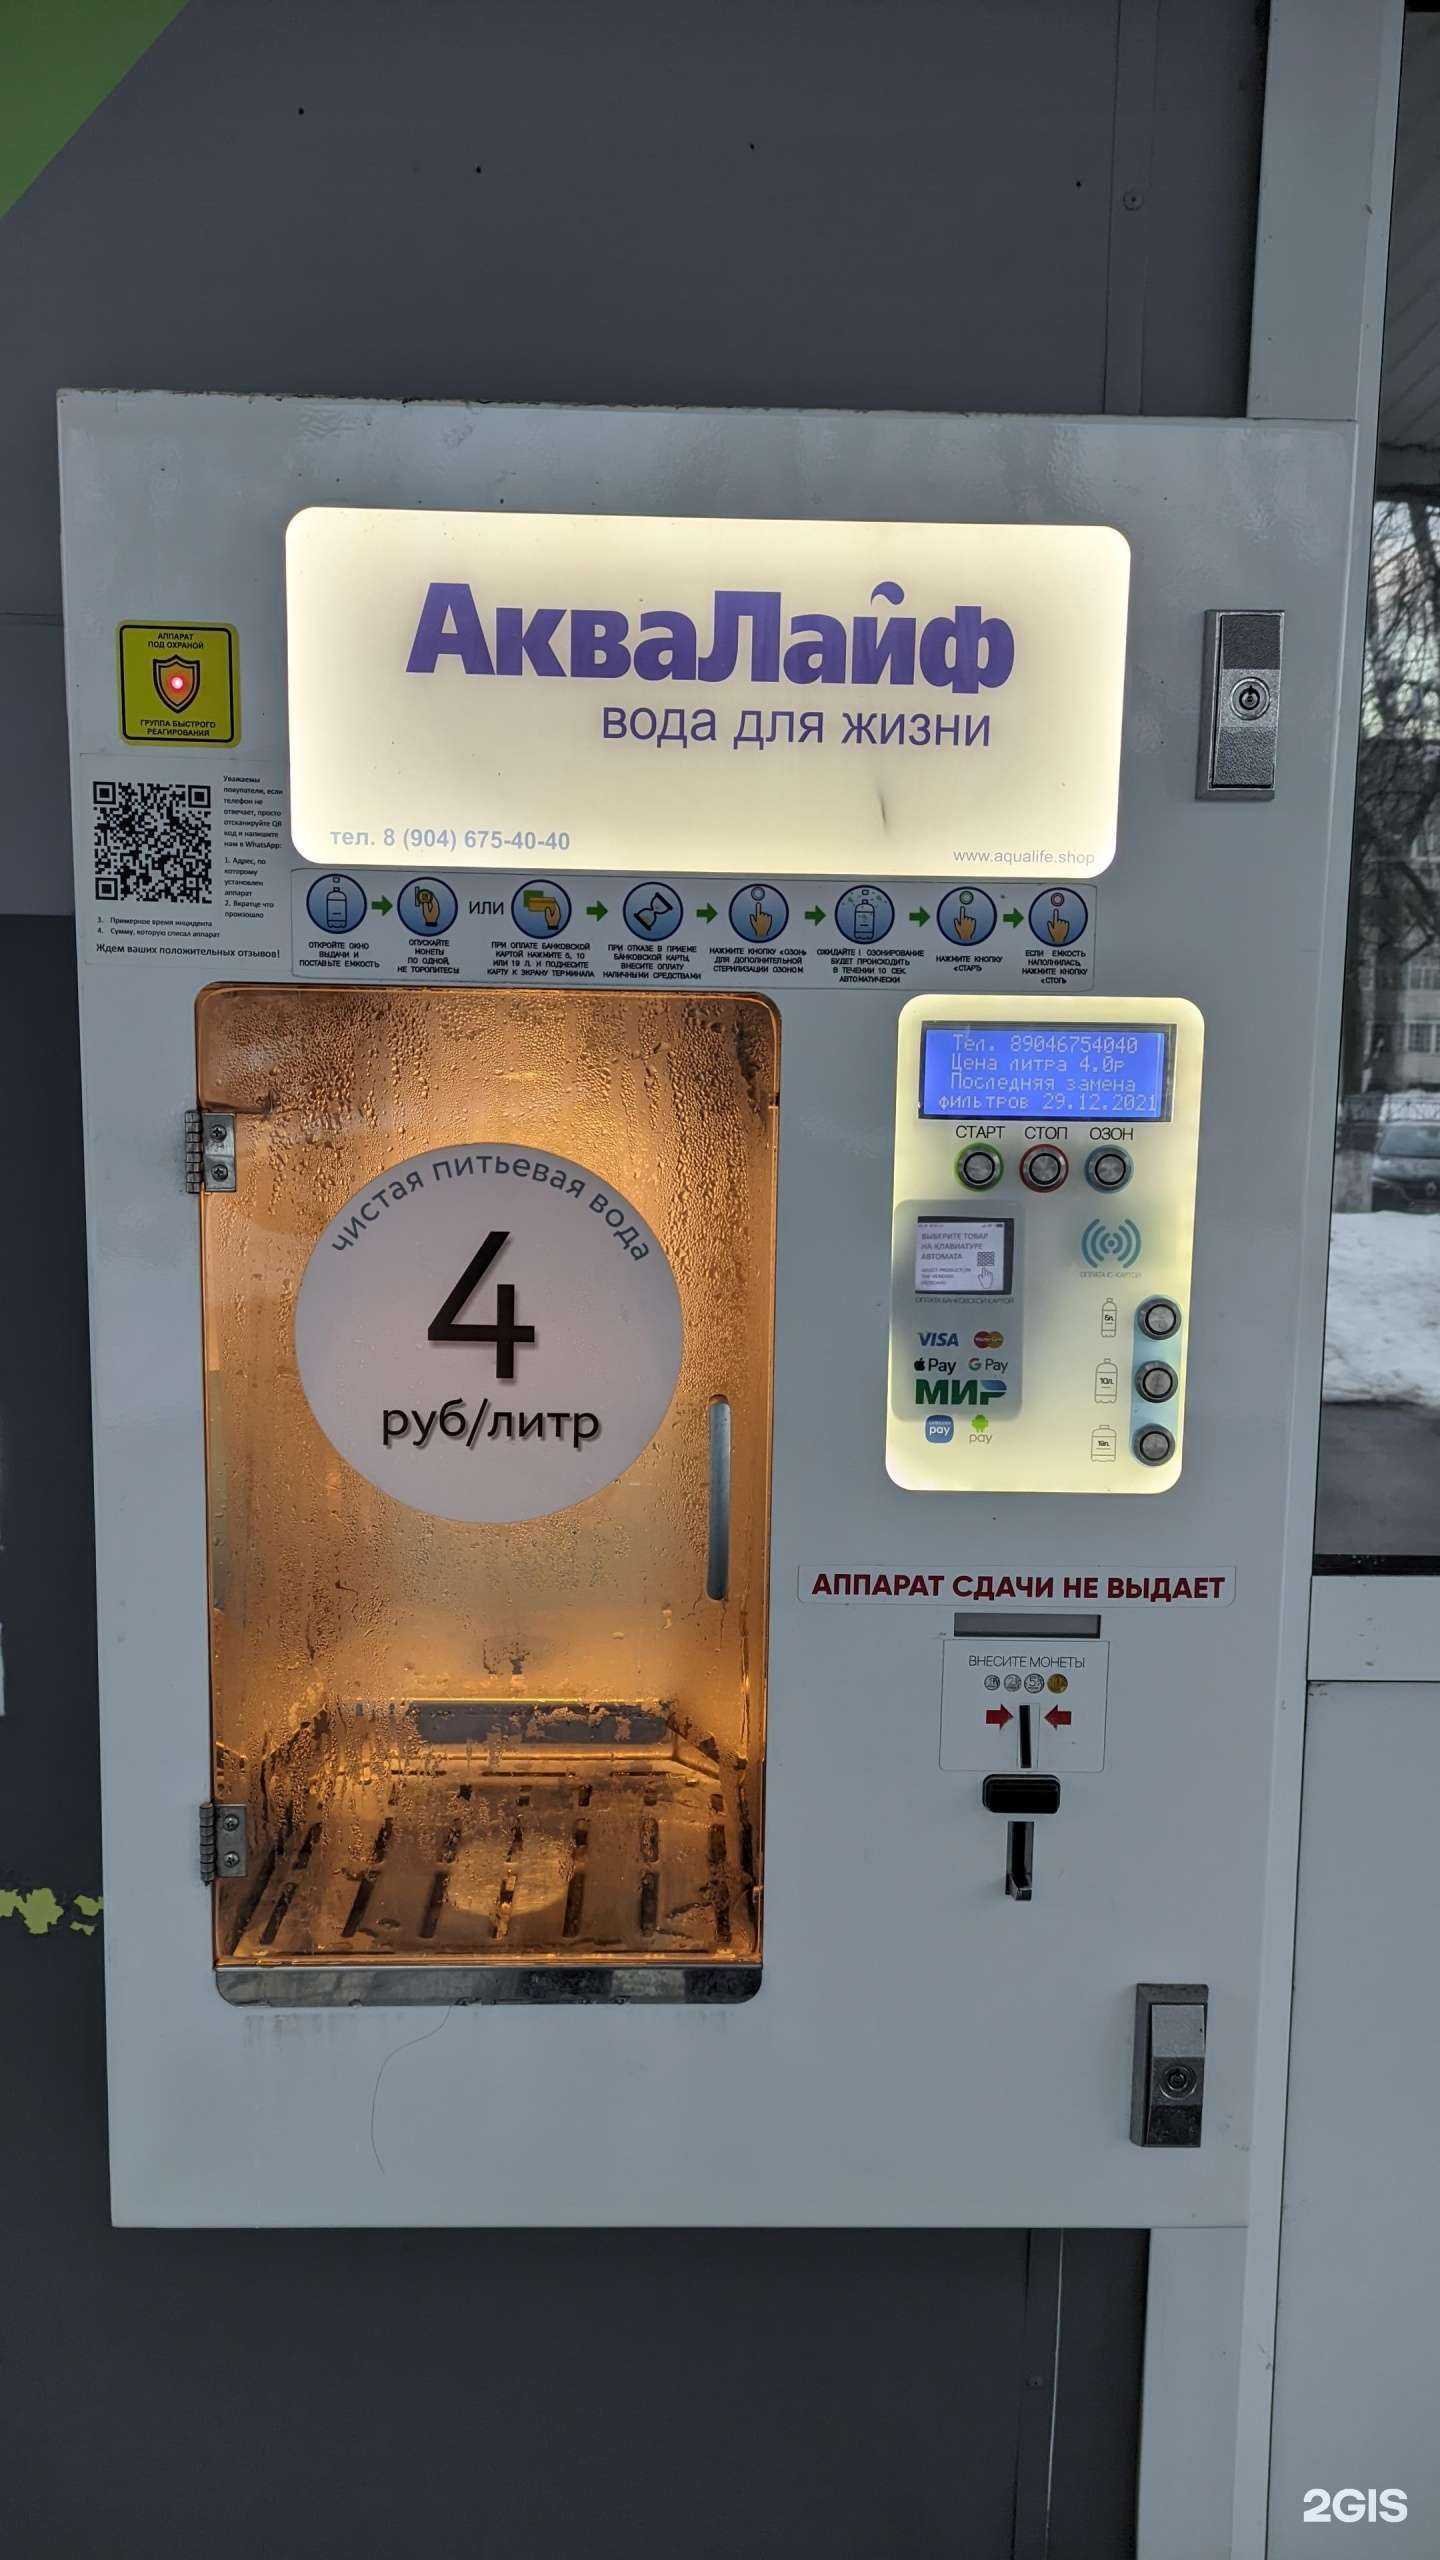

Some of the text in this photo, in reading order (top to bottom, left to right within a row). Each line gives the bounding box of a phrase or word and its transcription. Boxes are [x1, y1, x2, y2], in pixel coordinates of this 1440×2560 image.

[406, 582, 1014, 694] АкваЛайф
[166, 641, 204, 649] ОХРАНОЙ
[172, 720, 216, 728] БЫСТРОГО
[603, 706, 990, 750] вода для жизни
[147, 728, 210, 736] РЕАГИРОВАНИЯ
[330, 828, 570, 851] тел. 8 (904) 675-40-40
[953, 848, 1095, 865] www.aqualife.shop
[468, 901, 504, 915] ИЛИ
[308, 941, 369, 950] ОТКРОЙТЕ ОКНО
[408, 939, 450, 947] ОПУСКАЙТЕ
[491, 941, 590, 951] ПРИ ОПЛАТЕ БАНКОВСКОЙ
[96, 943, 280, 959] Ждем ваших положительных отзывов!
[607, 944, 623, 952] ПРИ
[627, 944, 654, 952] ОТКАЗЕ
[666, 945, 697, 953] ПРИЕМЕ
[709, 947, 745, 955] НАЖМИТЕ
[747, 948, 776, 956] КНОПКУ
[816, 948, 925, 957] ОЖИДАЙТЕ ОЗОНИРОВАНИЕ
[353, 951, 359, 959] И
[495, 950, 524, 958] КАРТОЙ
[527, 951, 562, 959] НАЖМИТЕ
[614, 952, 662, 961] БАНКОВСКОЙ
[935, 955, 1003, 963] НАЖМИТЕ КНОПКУ
[1052, 950, 1086, 958] ЕМКОСТЬ
[299, 959, 380, 968] ПОСТАВЬТЕ ЕМКОСТЬ
[546, 960, 589, 969] ПОДНЕСИТЕ
[714, 956, 802, 965] ДЛЯ ДОПОЛНИТЕЛЬНОЙ
[831, 958, 910, 967] БУДЕТ ПРОИСХОДИТЬ
[620, 962, 684, 970] ВНЕСИТЕ ОПЛАТУ
[713, 965, 804, 974] СТЕРИЛИЗАЦИИ ОЗОНОМ
[833, 966, 839, 974] В
[842, 966, 875, 974] ТЕЧЕНИИ
[487, 968, 595, 978] КАРТУ К ЭКРАНУ ТЕРМИНАЛА
[603, 971, 701, 980] НАЛИЧНЫМИ СРЕДСТВАМИ
[1059, 968, 1088, 976] КНОПКУ
[839, 975, 900, 984] АВТОМАТИЧЕСКИ
[953, 1033, 1138, 1053] Тел. 89046754040
[951, 1053, 1126, 1073] Цена литра 4.0р
[951, 1072, 1136, 1092] Последняя замена
[938, 1094, 1157, 1112] фильтров 29.12.2021
[956, 1124, 1134, 1141] СТАРТ СТОП ОЗОН
[331, 1155, 650, 1262] чистая питьевая вода
[427, 1231, 535, 1379] 4
[918, 1332, 959, 1347] VISA
[928, 1358, 957, 1375] Pay
[968, 1357, 1009, 1374] G Pay
[915, 1379, 1007, 1405] МИР
[382, 1398, 600, 1449] руб/литр
[929, 1426, 951, 1436] pay
[969, 1434, 993, 1445] pay
[811, 1573, 1226, 1602] АППАРАТ СДАЧИ НЕ ВЫДАЕТ
[968, 1655, 1085, 1669] ВНЕСИТЕ МОНЕТЫ
